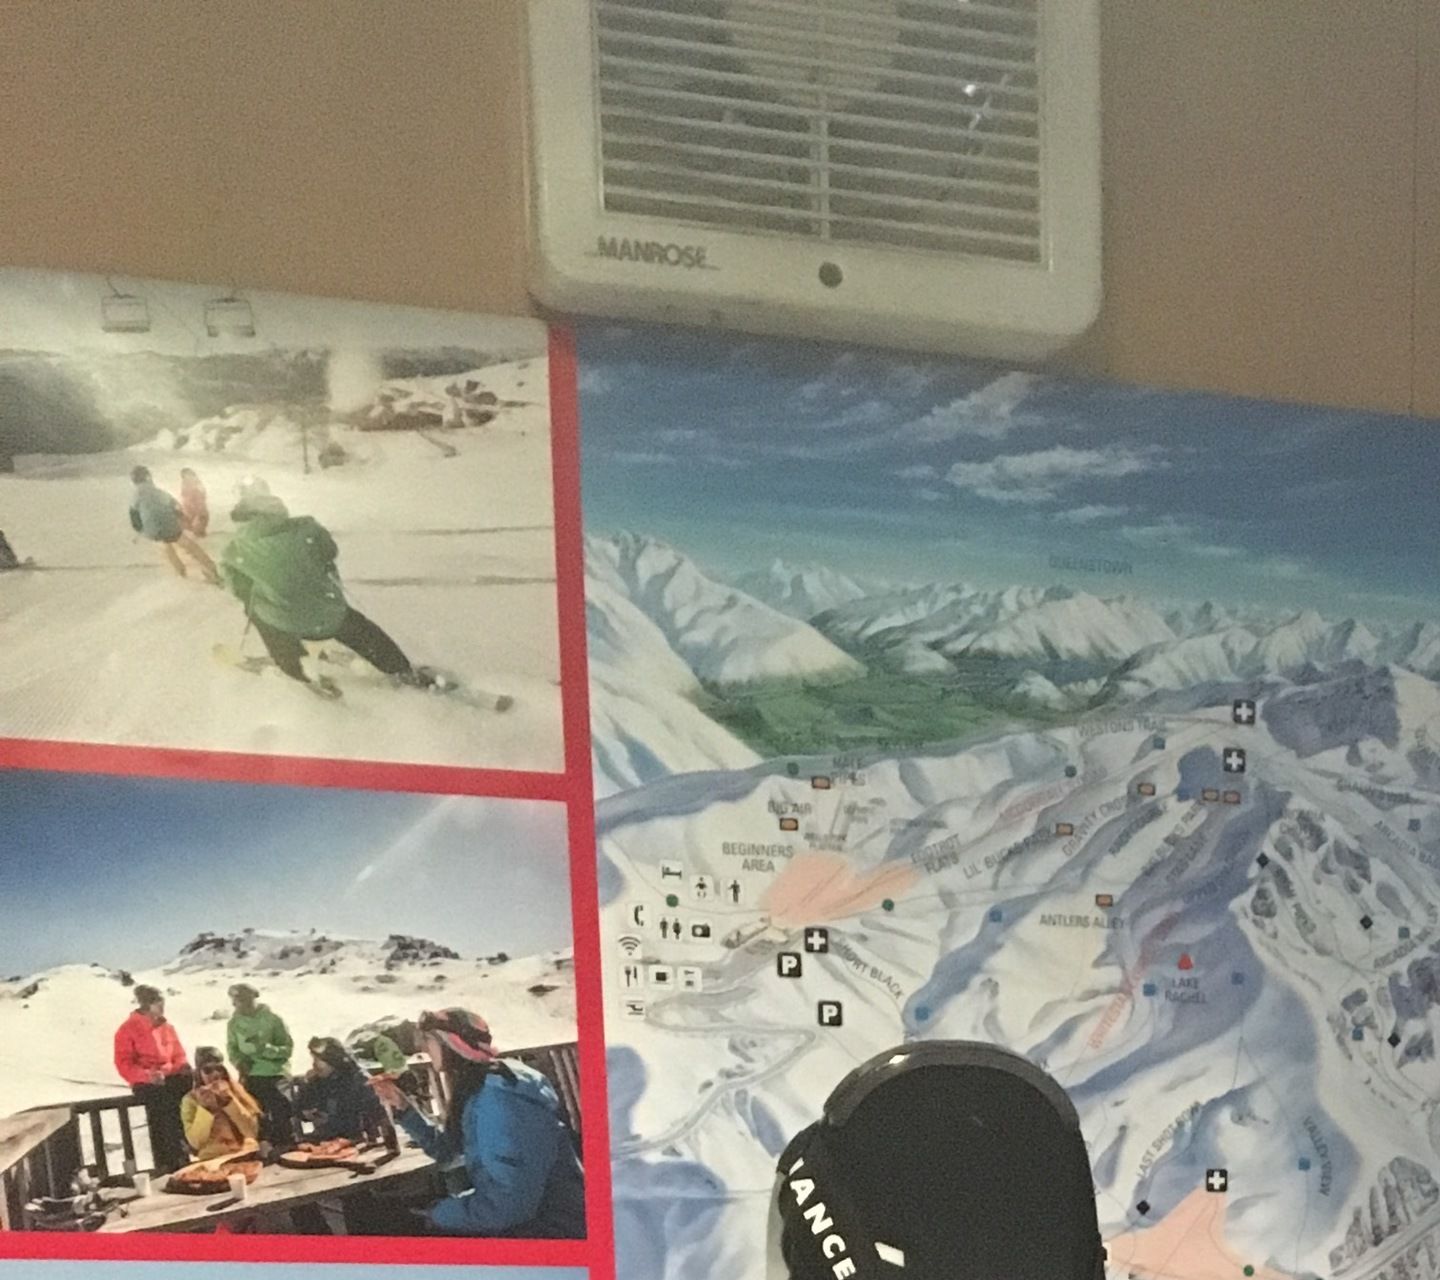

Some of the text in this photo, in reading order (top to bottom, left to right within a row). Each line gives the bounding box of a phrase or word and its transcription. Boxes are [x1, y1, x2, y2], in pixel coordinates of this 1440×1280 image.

[597, 235, 707, 268] MANROSE
[722, 841, 795, 859] BEGINNERS
[742, 858, 776, 873] AREA
